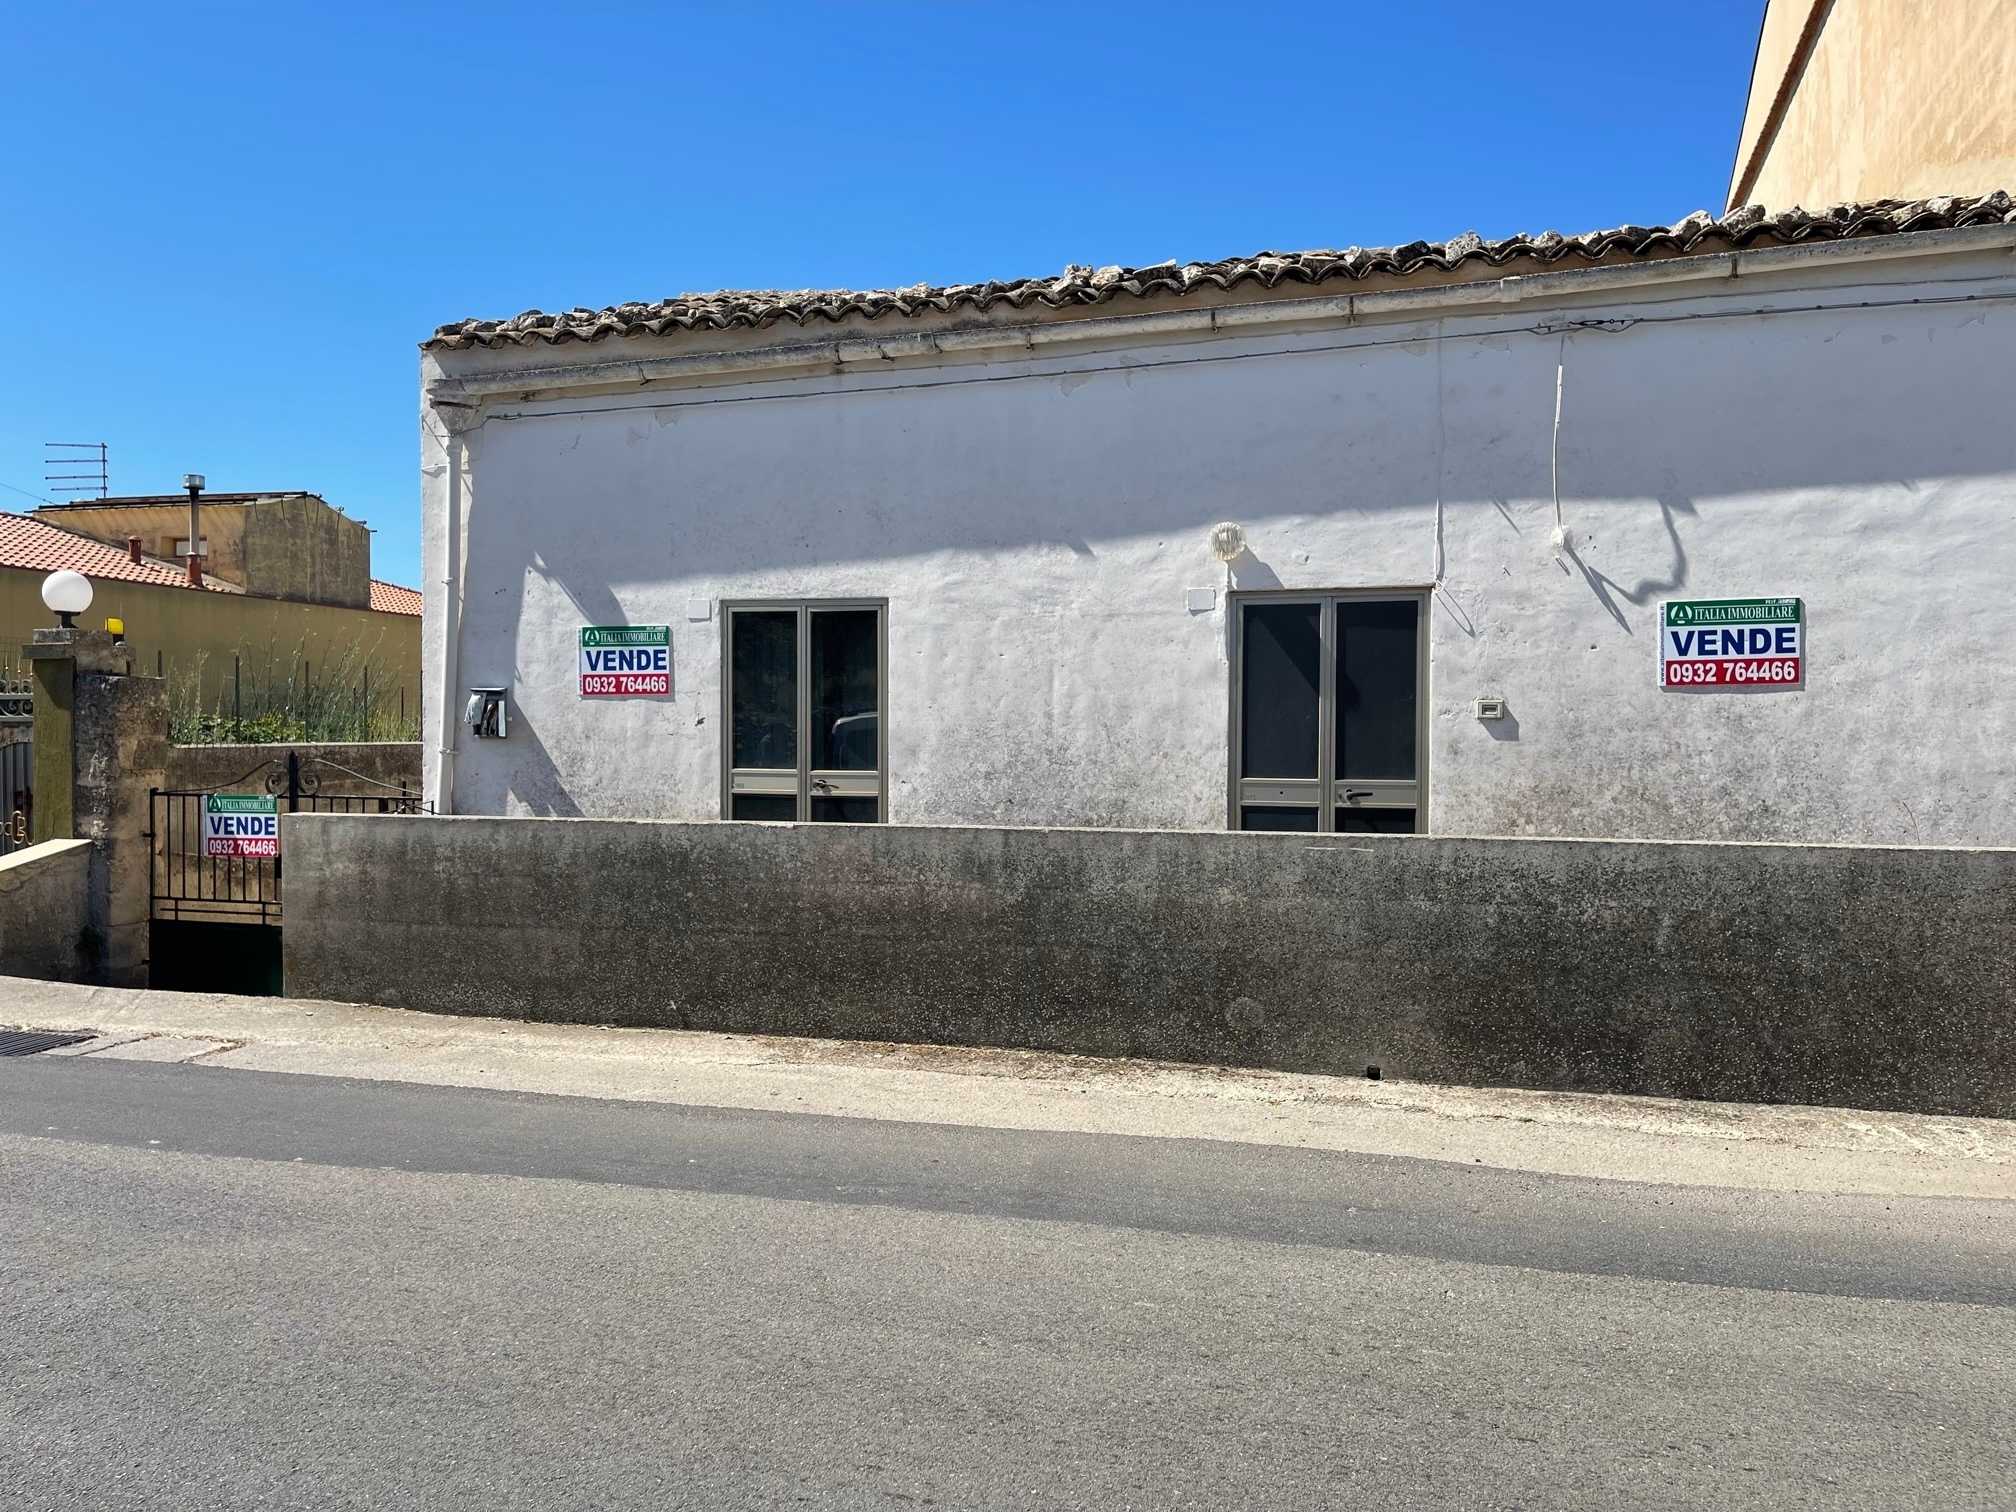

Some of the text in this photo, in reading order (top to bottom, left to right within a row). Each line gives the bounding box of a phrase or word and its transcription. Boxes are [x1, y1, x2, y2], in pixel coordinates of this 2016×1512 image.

[1694, 608, 1726, 621] ITALIA
[1727, 606, 1794, 619] IMMOBILIARE
[600, 632, 621, 643] ITALIA
[622, 631, 665, 642] IMMOBILIARE
[1670, 627, 1797, 657] VENDE
[585, 649, 667, 671] VENDE
[1669, 661, 1796, 683] 0932 764466
[585, 676, 667, 693] 0932 764466
[209, 816, 276, 835] VENDE
[209, 839, 276, 855] 0932 764466
